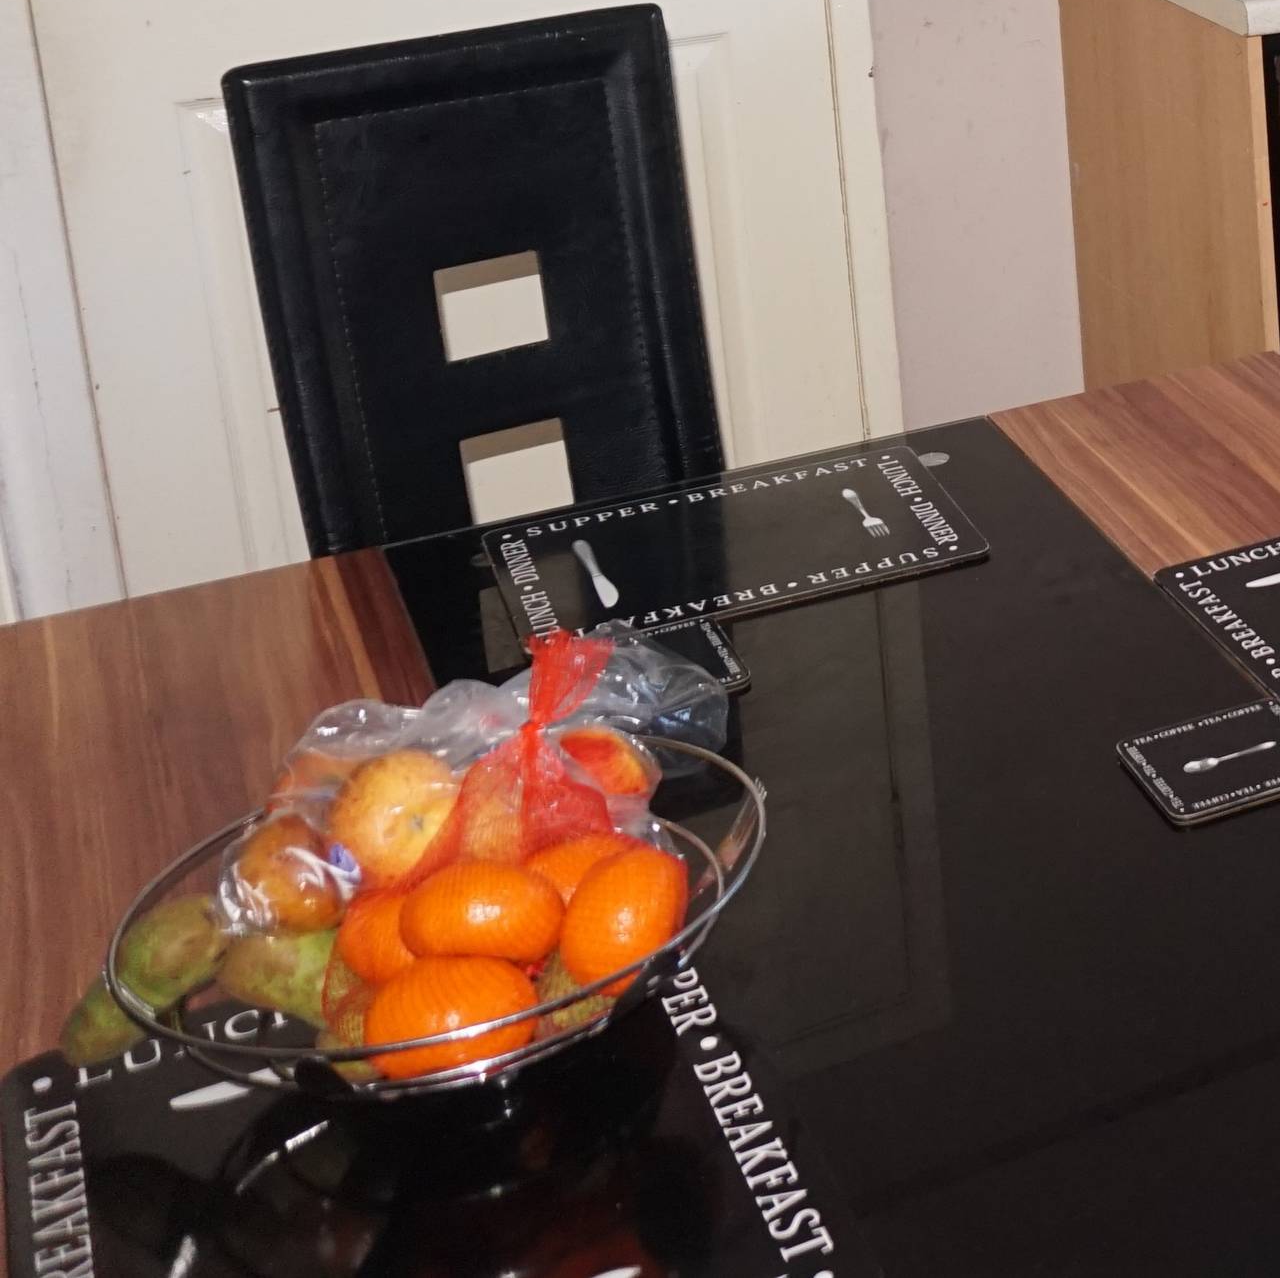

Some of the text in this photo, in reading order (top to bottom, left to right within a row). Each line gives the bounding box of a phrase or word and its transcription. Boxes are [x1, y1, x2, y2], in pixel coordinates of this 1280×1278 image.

[526, 456, 869, 538] SUPPER BREAKFAST
[876, 458, 960, 546] LUNCH DINNER
[501, 538, 540, 586] DINNER
[806, 546, 940, 587] SUPPER
[1176, 581, 1274, 661] BREAKFAST
[1133, 736, 1153, 746] TEA
[1203, 716, 1222, 726] TEA
[75, 1008, 288, 1089] LUC
[24, 1100, 95, 1278] REAKFAST
[693, 1050, 835, 1263] BREAKFAST
